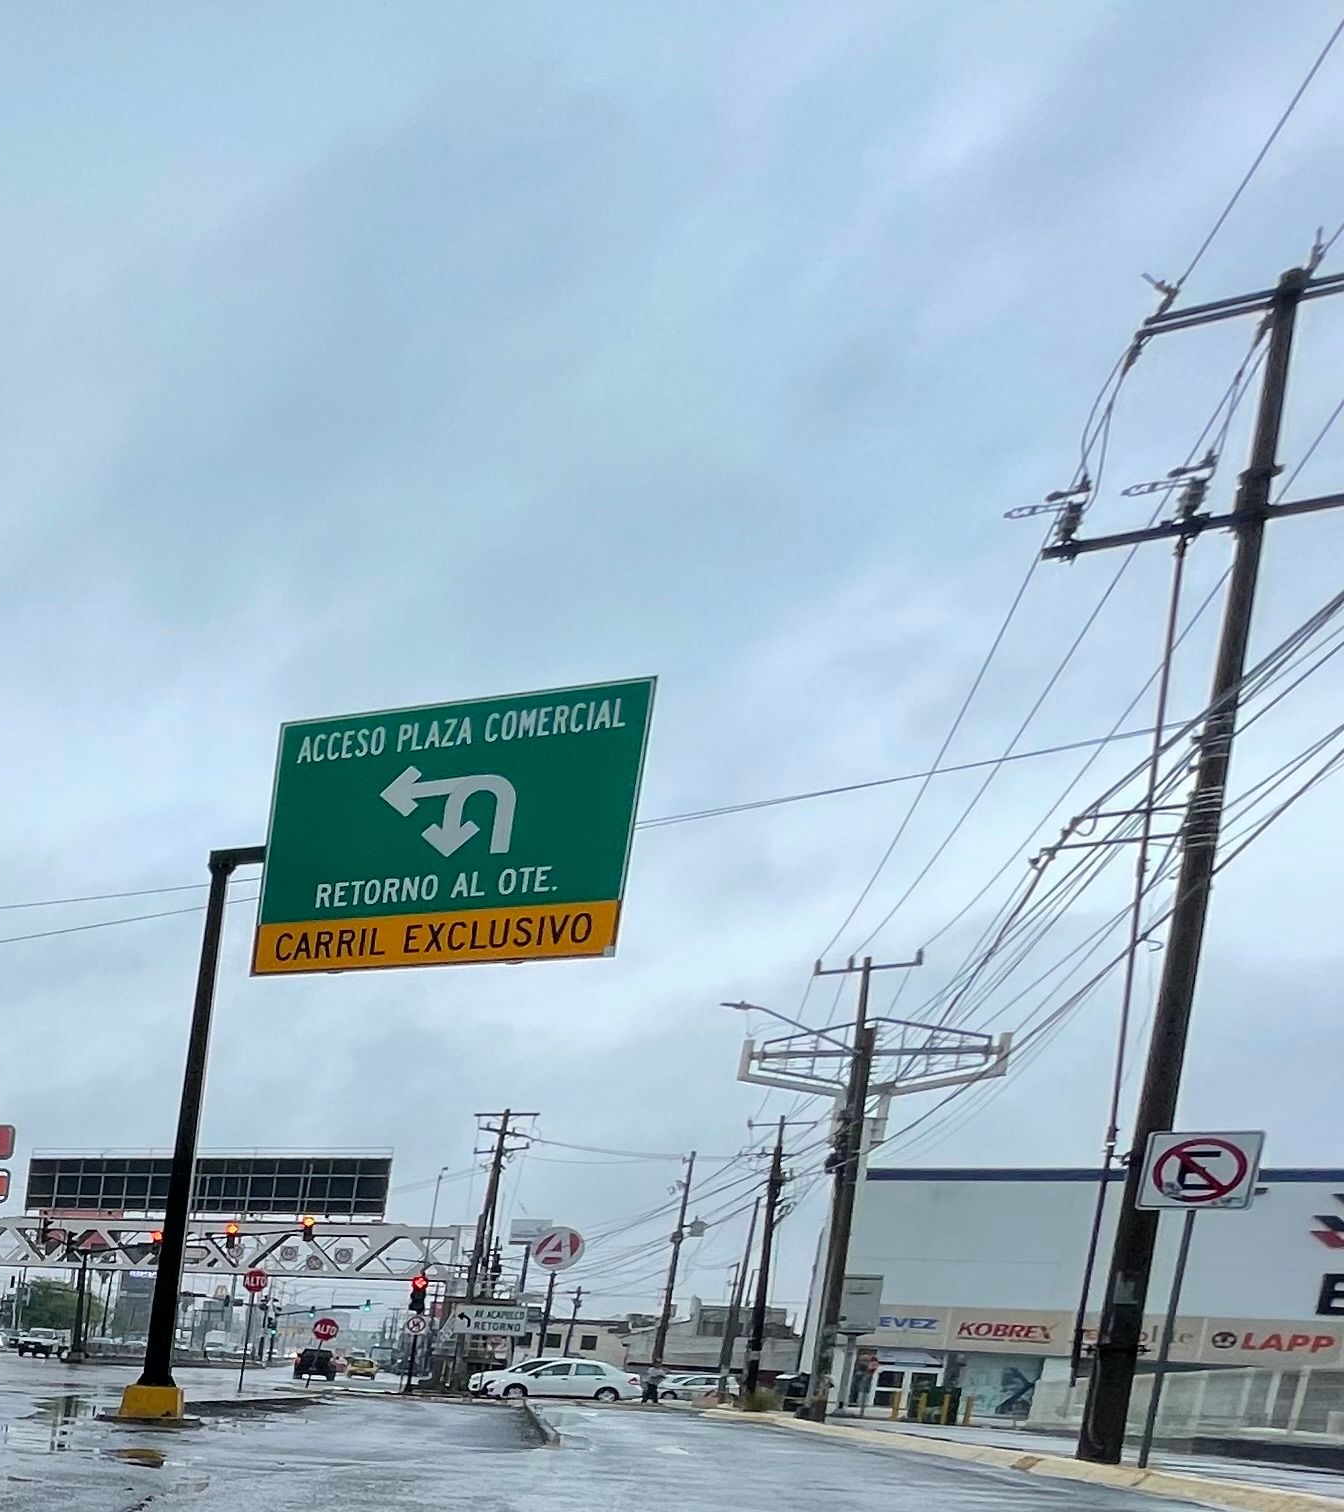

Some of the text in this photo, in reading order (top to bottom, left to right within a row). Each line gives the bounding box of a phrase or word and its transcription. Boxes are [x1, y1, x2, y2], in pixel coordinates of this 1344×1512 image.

[297, 698, 626, 763] ACCESO PLAZA COMERCIAL
[314, 866, 557, 909] RETORNO AL OTE.
[275, 912, 592, 961] CARRIL EXCLUSIVO
[245, 1276, 267, 1287] ALTO
[314, 1323, 338, 1336] ALTO
[474, 1321, 521, 1332] RETORNO
[957, 1321, 1059, 1340] KOBREX
[1240, 1332, 1336, 1354] LAPP
